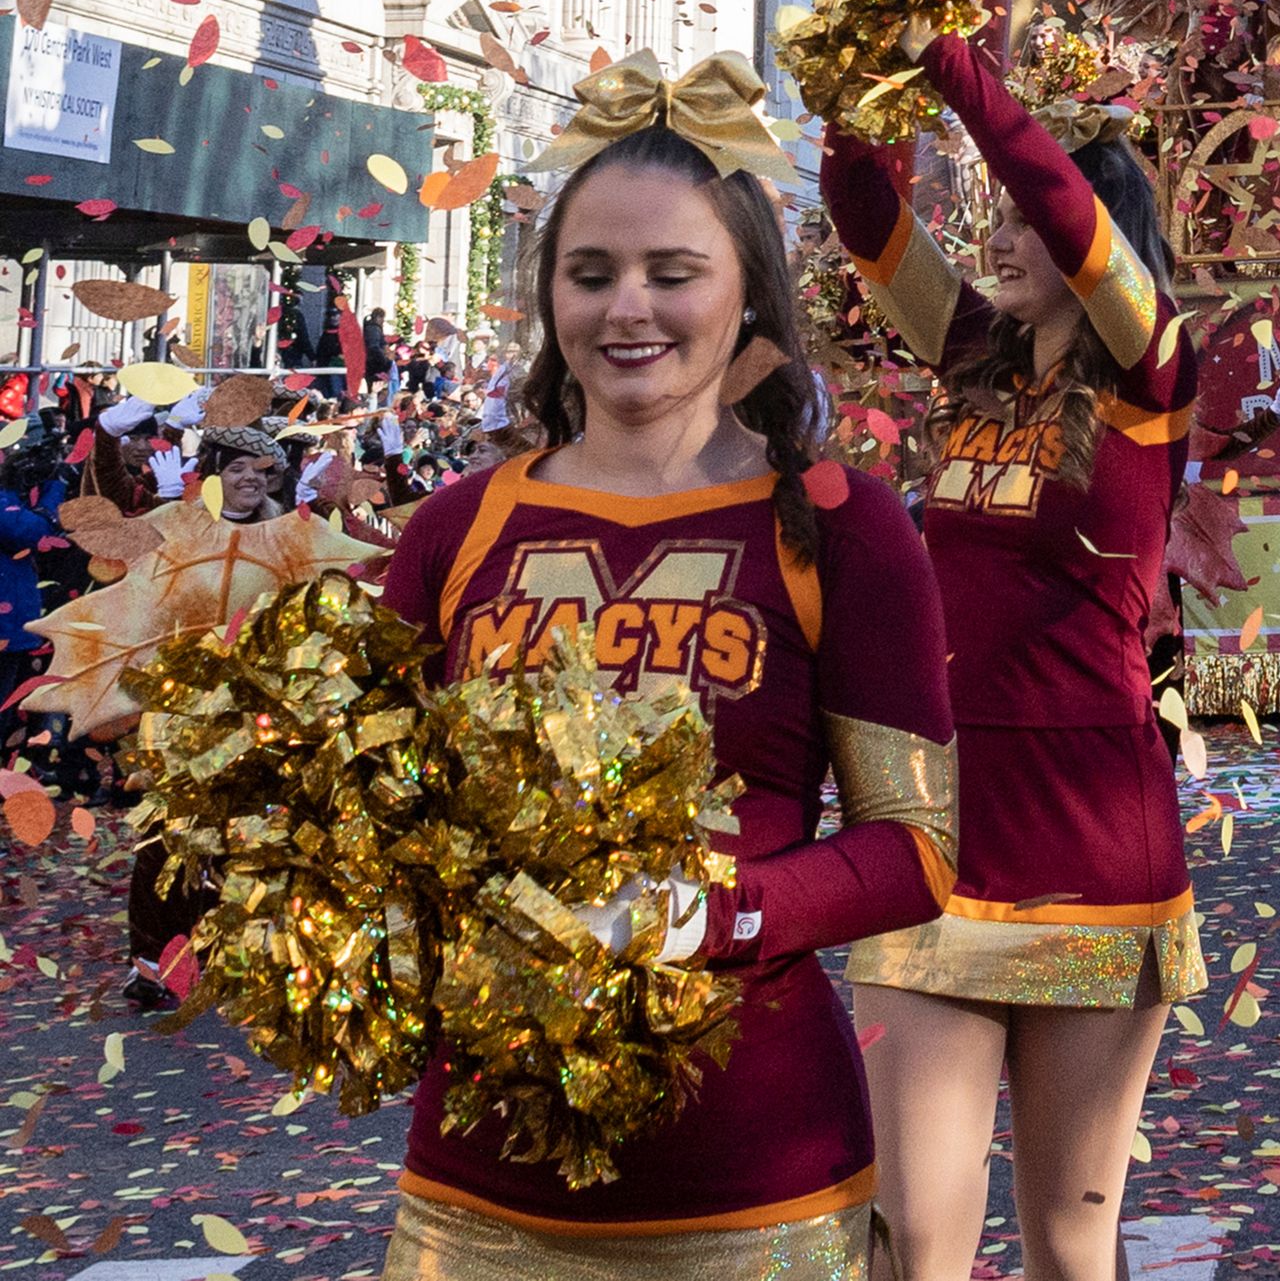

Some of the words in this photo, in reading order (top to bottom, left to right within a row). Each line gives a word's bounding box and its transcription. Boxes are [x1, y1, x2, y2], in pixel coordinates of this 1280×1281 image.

[71, 37, 91, 64] Park
[92, 42, 113, 69] West
[463, 599, 752, 682] MACYS
